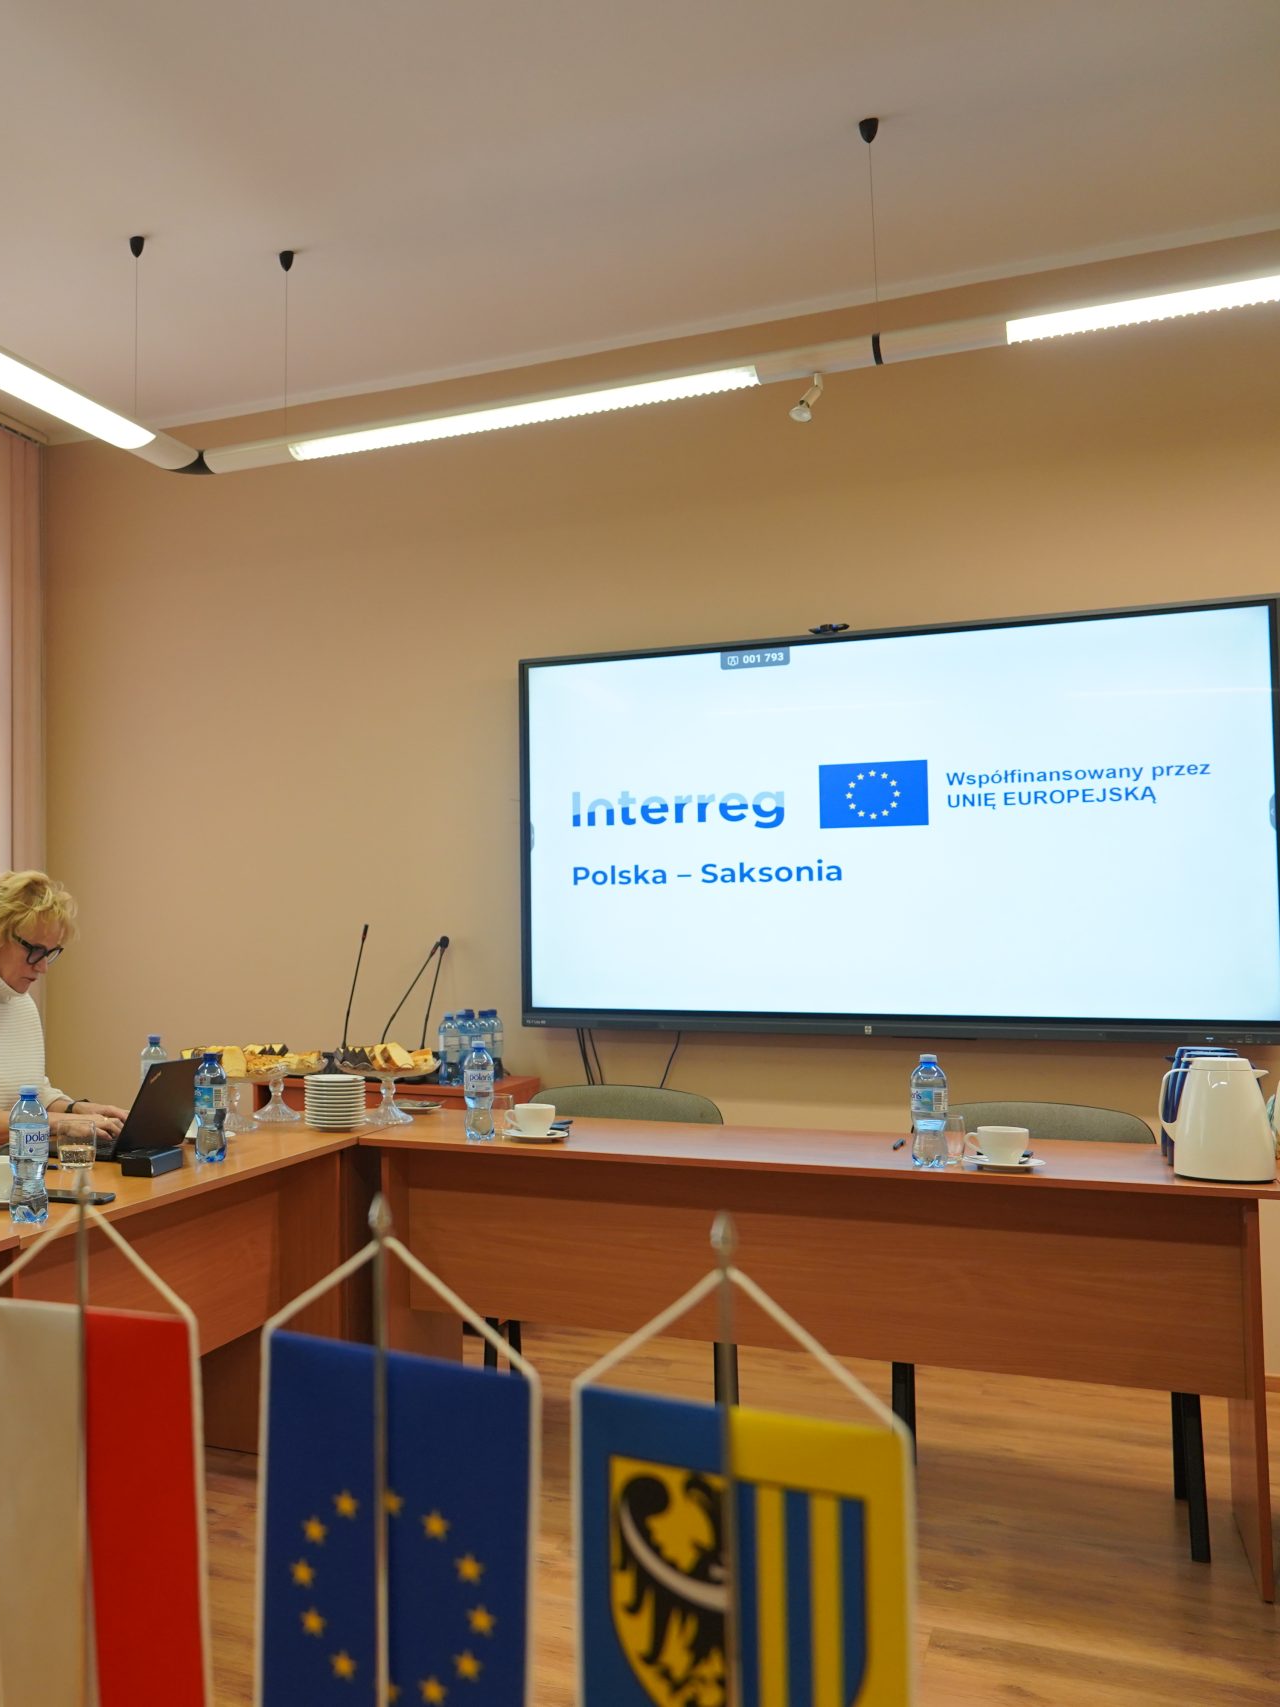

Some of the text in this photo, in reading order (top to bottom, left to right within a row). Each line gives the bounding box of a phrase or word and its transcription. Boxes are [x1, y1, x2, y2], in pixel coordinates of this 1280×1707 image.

[742, 652, 784, 664] 001 793
[946, 763, 1211, 788] Współfinansowany przez
[572, 791, 785, 829] Interreg
[947, 786, 1157, 810] UNIĘ EUROPEJSKĄ
[573, 865, 667, 886] Polska
[701, 859, 843, 884] Saksonia
